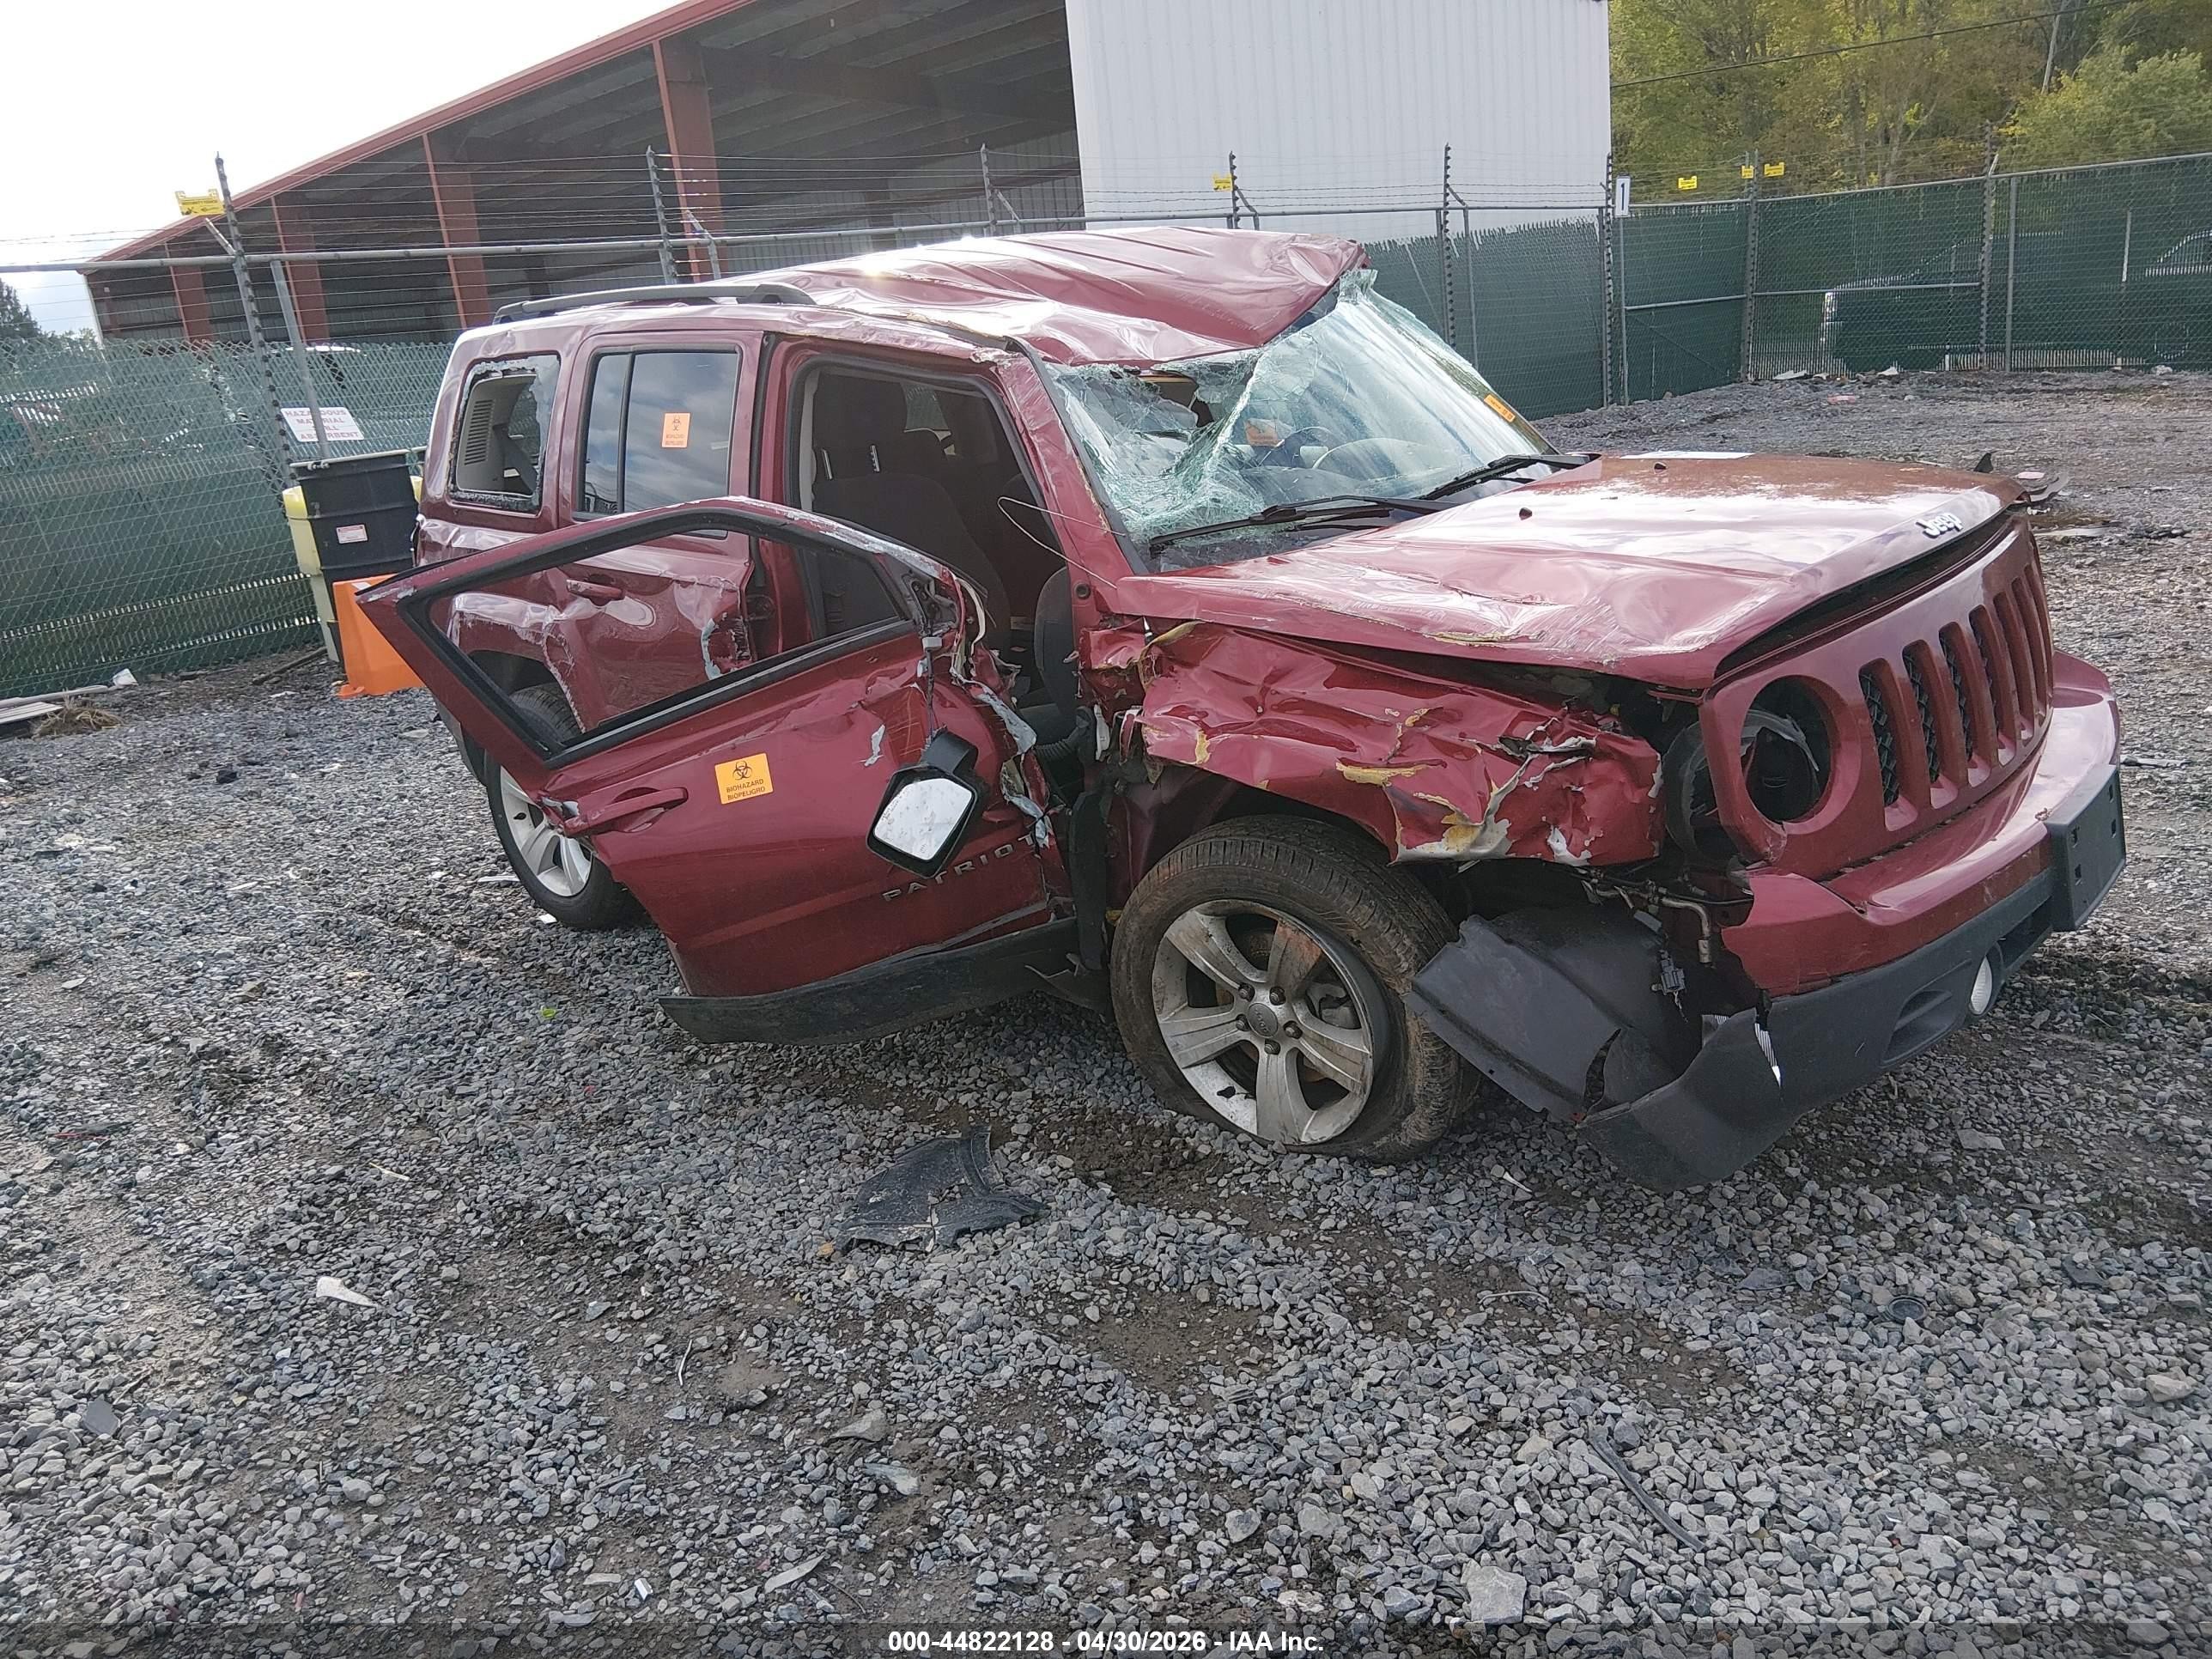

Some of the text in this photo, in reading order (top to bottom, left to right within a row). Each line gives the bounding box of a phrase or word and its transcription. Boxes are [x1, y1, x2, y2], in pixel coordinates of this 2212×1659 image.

[1915, 513, 1964, 538] Jeep
[726, 778, 764, 793] BIOHAZARD
[727, 787, 766, 801] BIOPELIGRO
[882, 833, 1035, 902] PATRIOT
